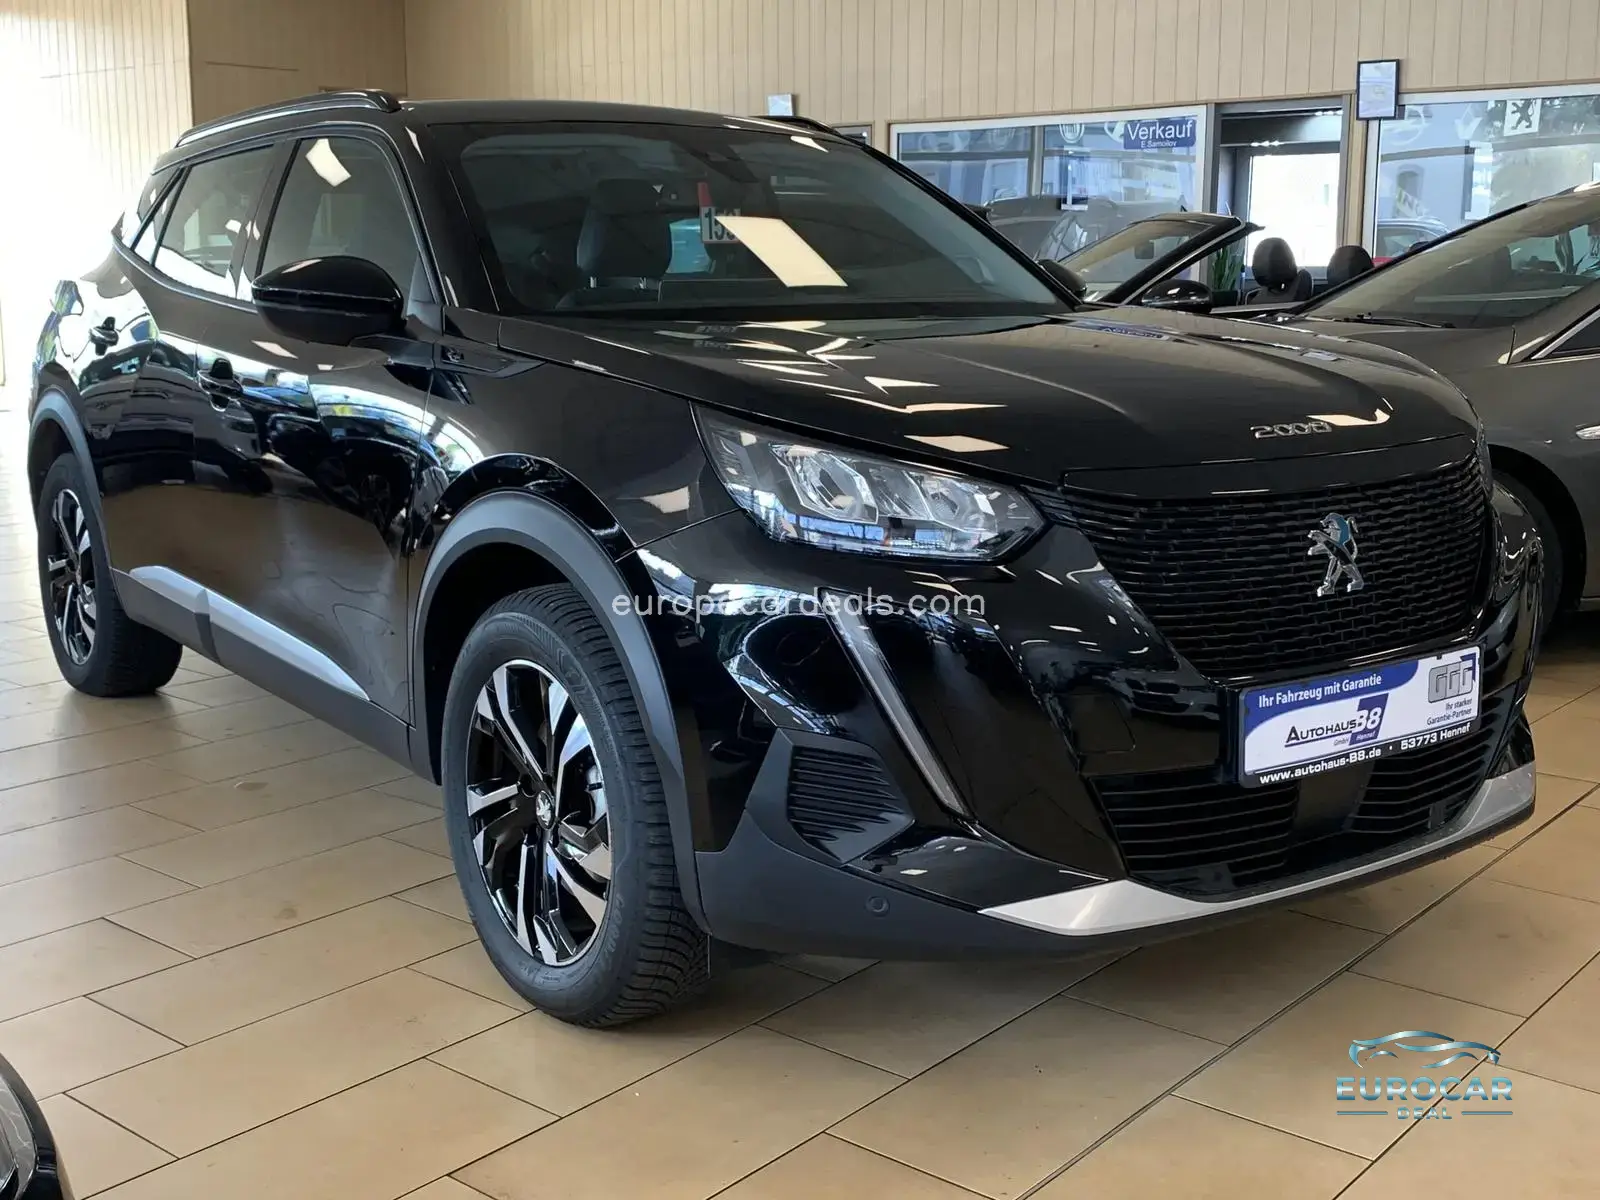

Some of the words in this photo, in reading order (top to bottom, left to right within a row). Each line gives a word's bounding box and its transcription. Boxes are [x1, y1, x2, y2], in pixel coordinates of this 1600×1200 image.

[1127, 121, 1193, 140] Verkauf
[1250, 421, 1332, 438] 2008
[1259, 695, 1274, 708] Ihr
[1276, 687, 1322, 704] Fahrzeug
[1324, 681, 1341, 696] mit
[1342, 674, 1382, 692] Garantie
[1445, 701, 1454, 711] Ihr
[1426, 708, 1472, 725] Garantie-Partner
[1400, 732, 1438, 750] 53773
[1440, 722, 1471, 740] Hennef
